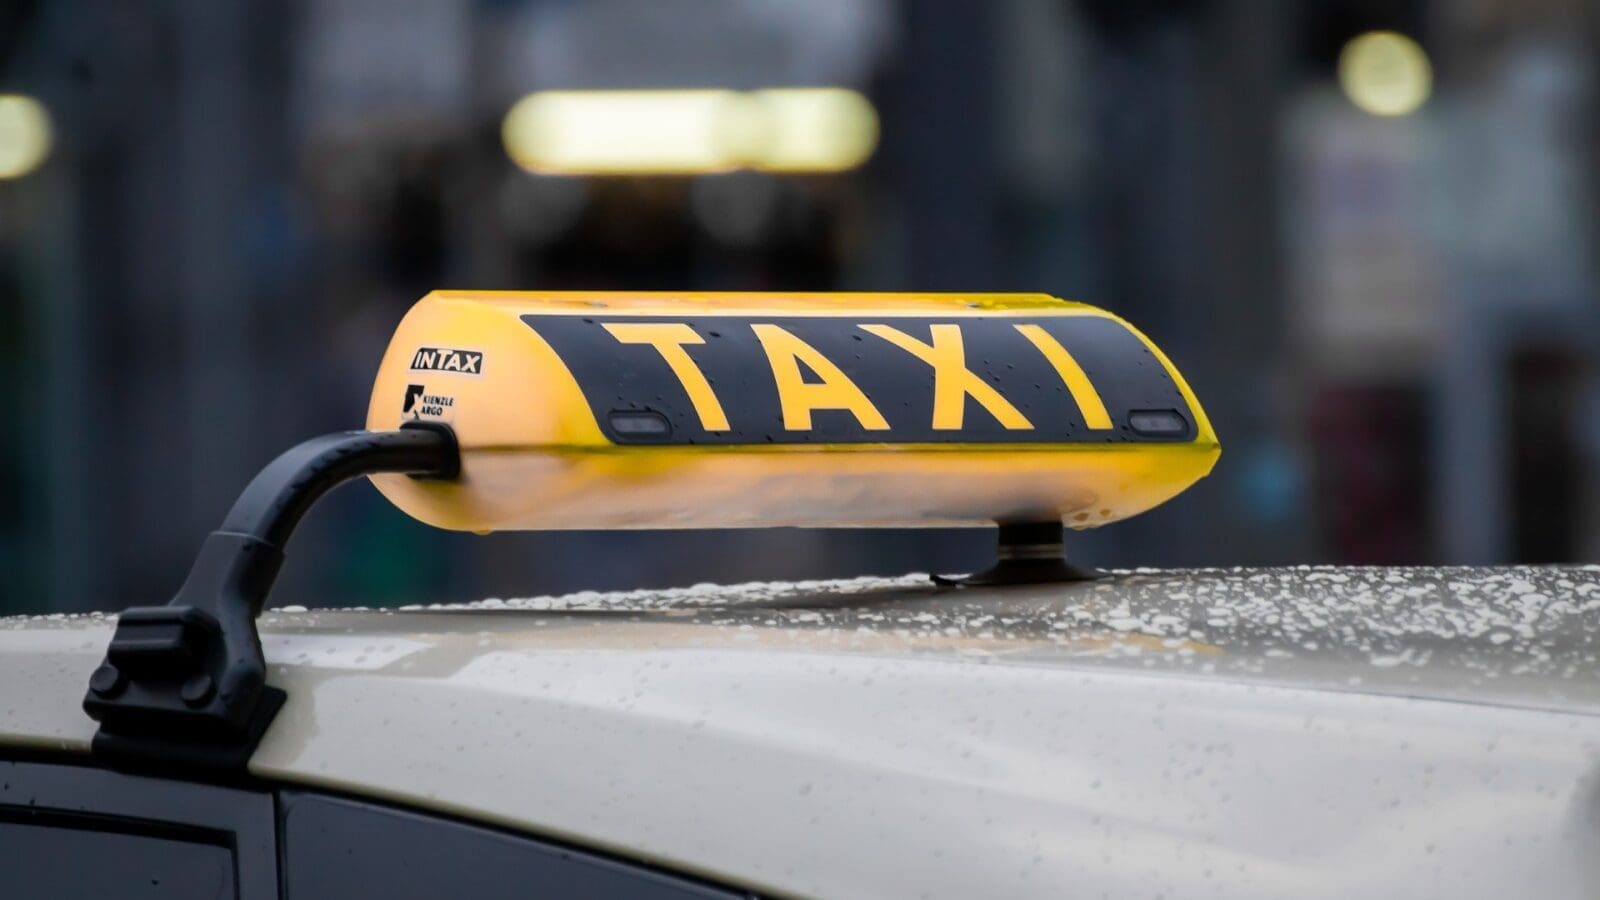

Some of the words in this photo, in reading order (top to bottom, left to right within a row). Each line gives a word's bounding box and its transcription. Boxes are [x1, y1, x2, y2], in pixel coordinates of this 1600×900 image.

[414, 349, 480, 373] INTAX
[600, 323, 1114, 431] TAXI
[423, 395, 454, 407] KIENZLE
[421, 406, 443, 416] ARGO
